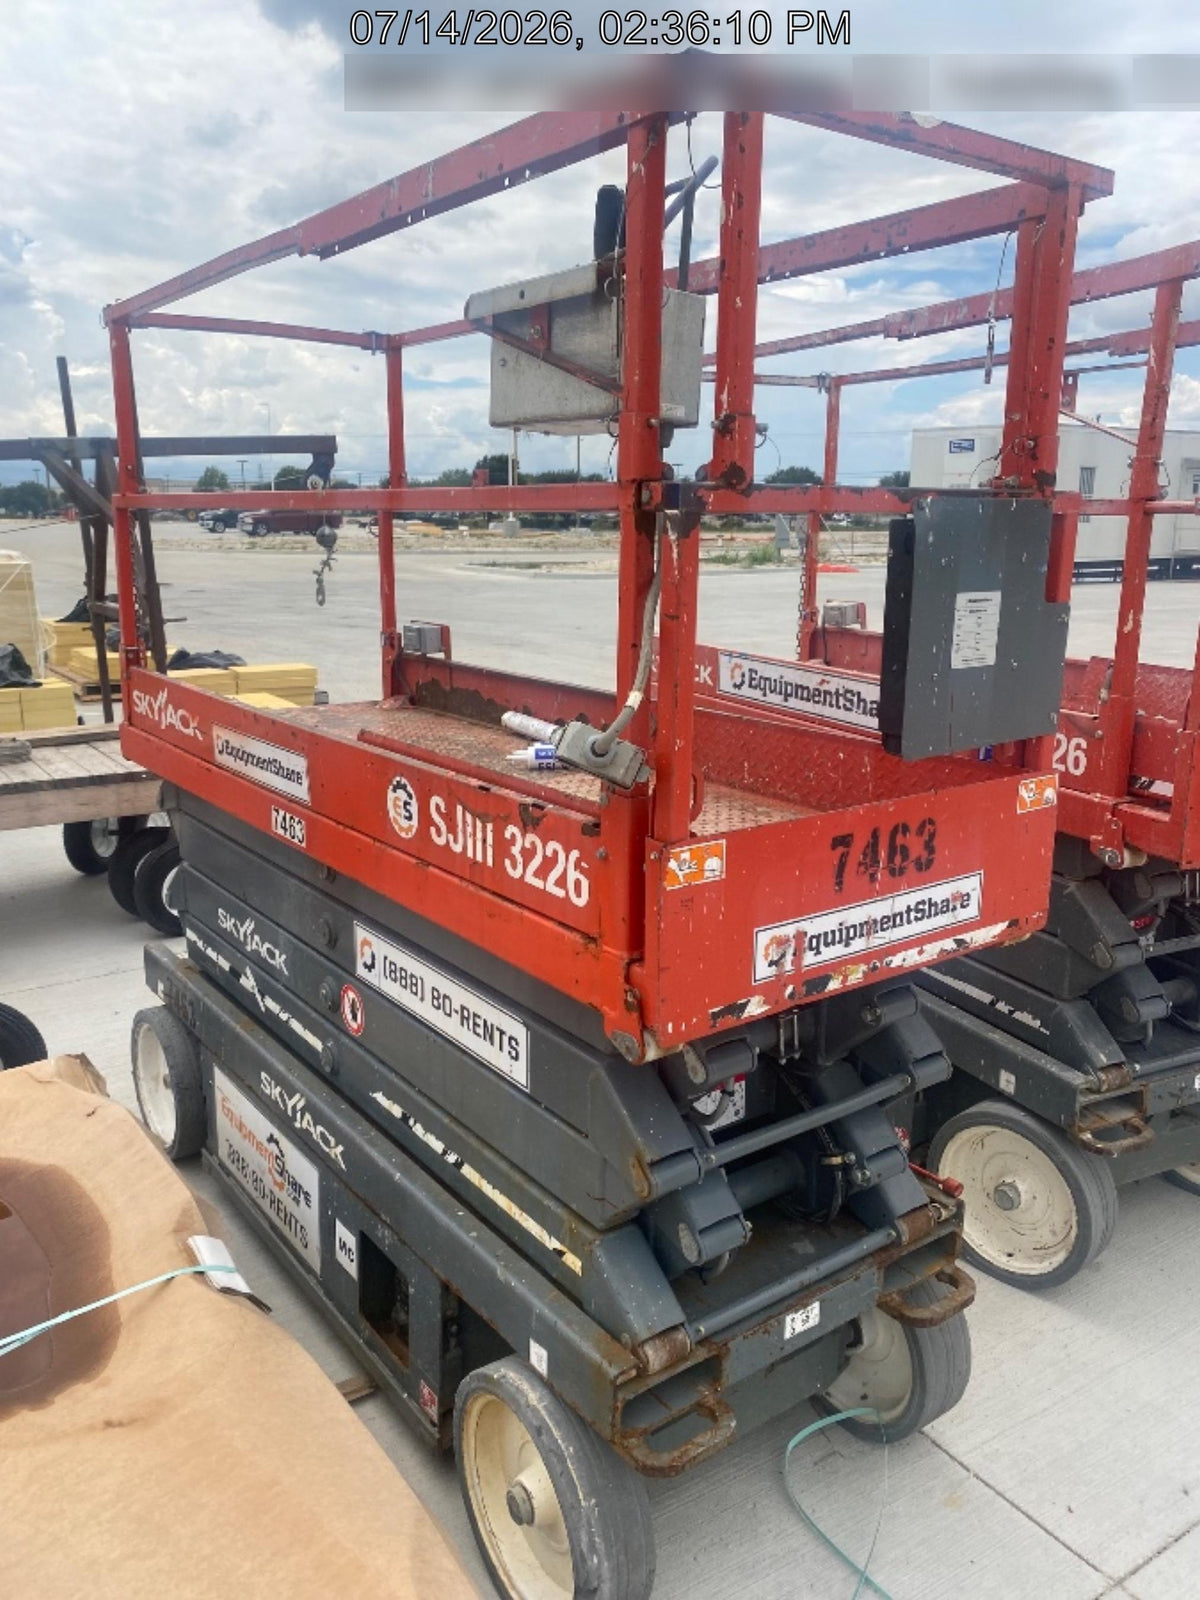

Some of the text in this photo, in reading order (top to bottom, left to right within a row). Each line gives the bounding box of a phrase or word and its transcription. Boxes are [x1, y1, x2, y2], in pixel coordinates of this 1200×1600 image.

[132, 688, 203, 740] SKYJACK
[748, 667, 879, 718] EquipmentSha
[223, 738, 304, 786] EquipmentShare
[1052, 733, 1087, 776] 26
[272, 808, 305, 844] 7463
[831, 818, 937, 893] 7463
[504, 824, 589, 907] 3226
[217, 908, 289, 976] SKYJACK
[383, 954, 520, 1063] (888) 80-RENTS
[260, 1071, 347, 1172] SKYJACK
